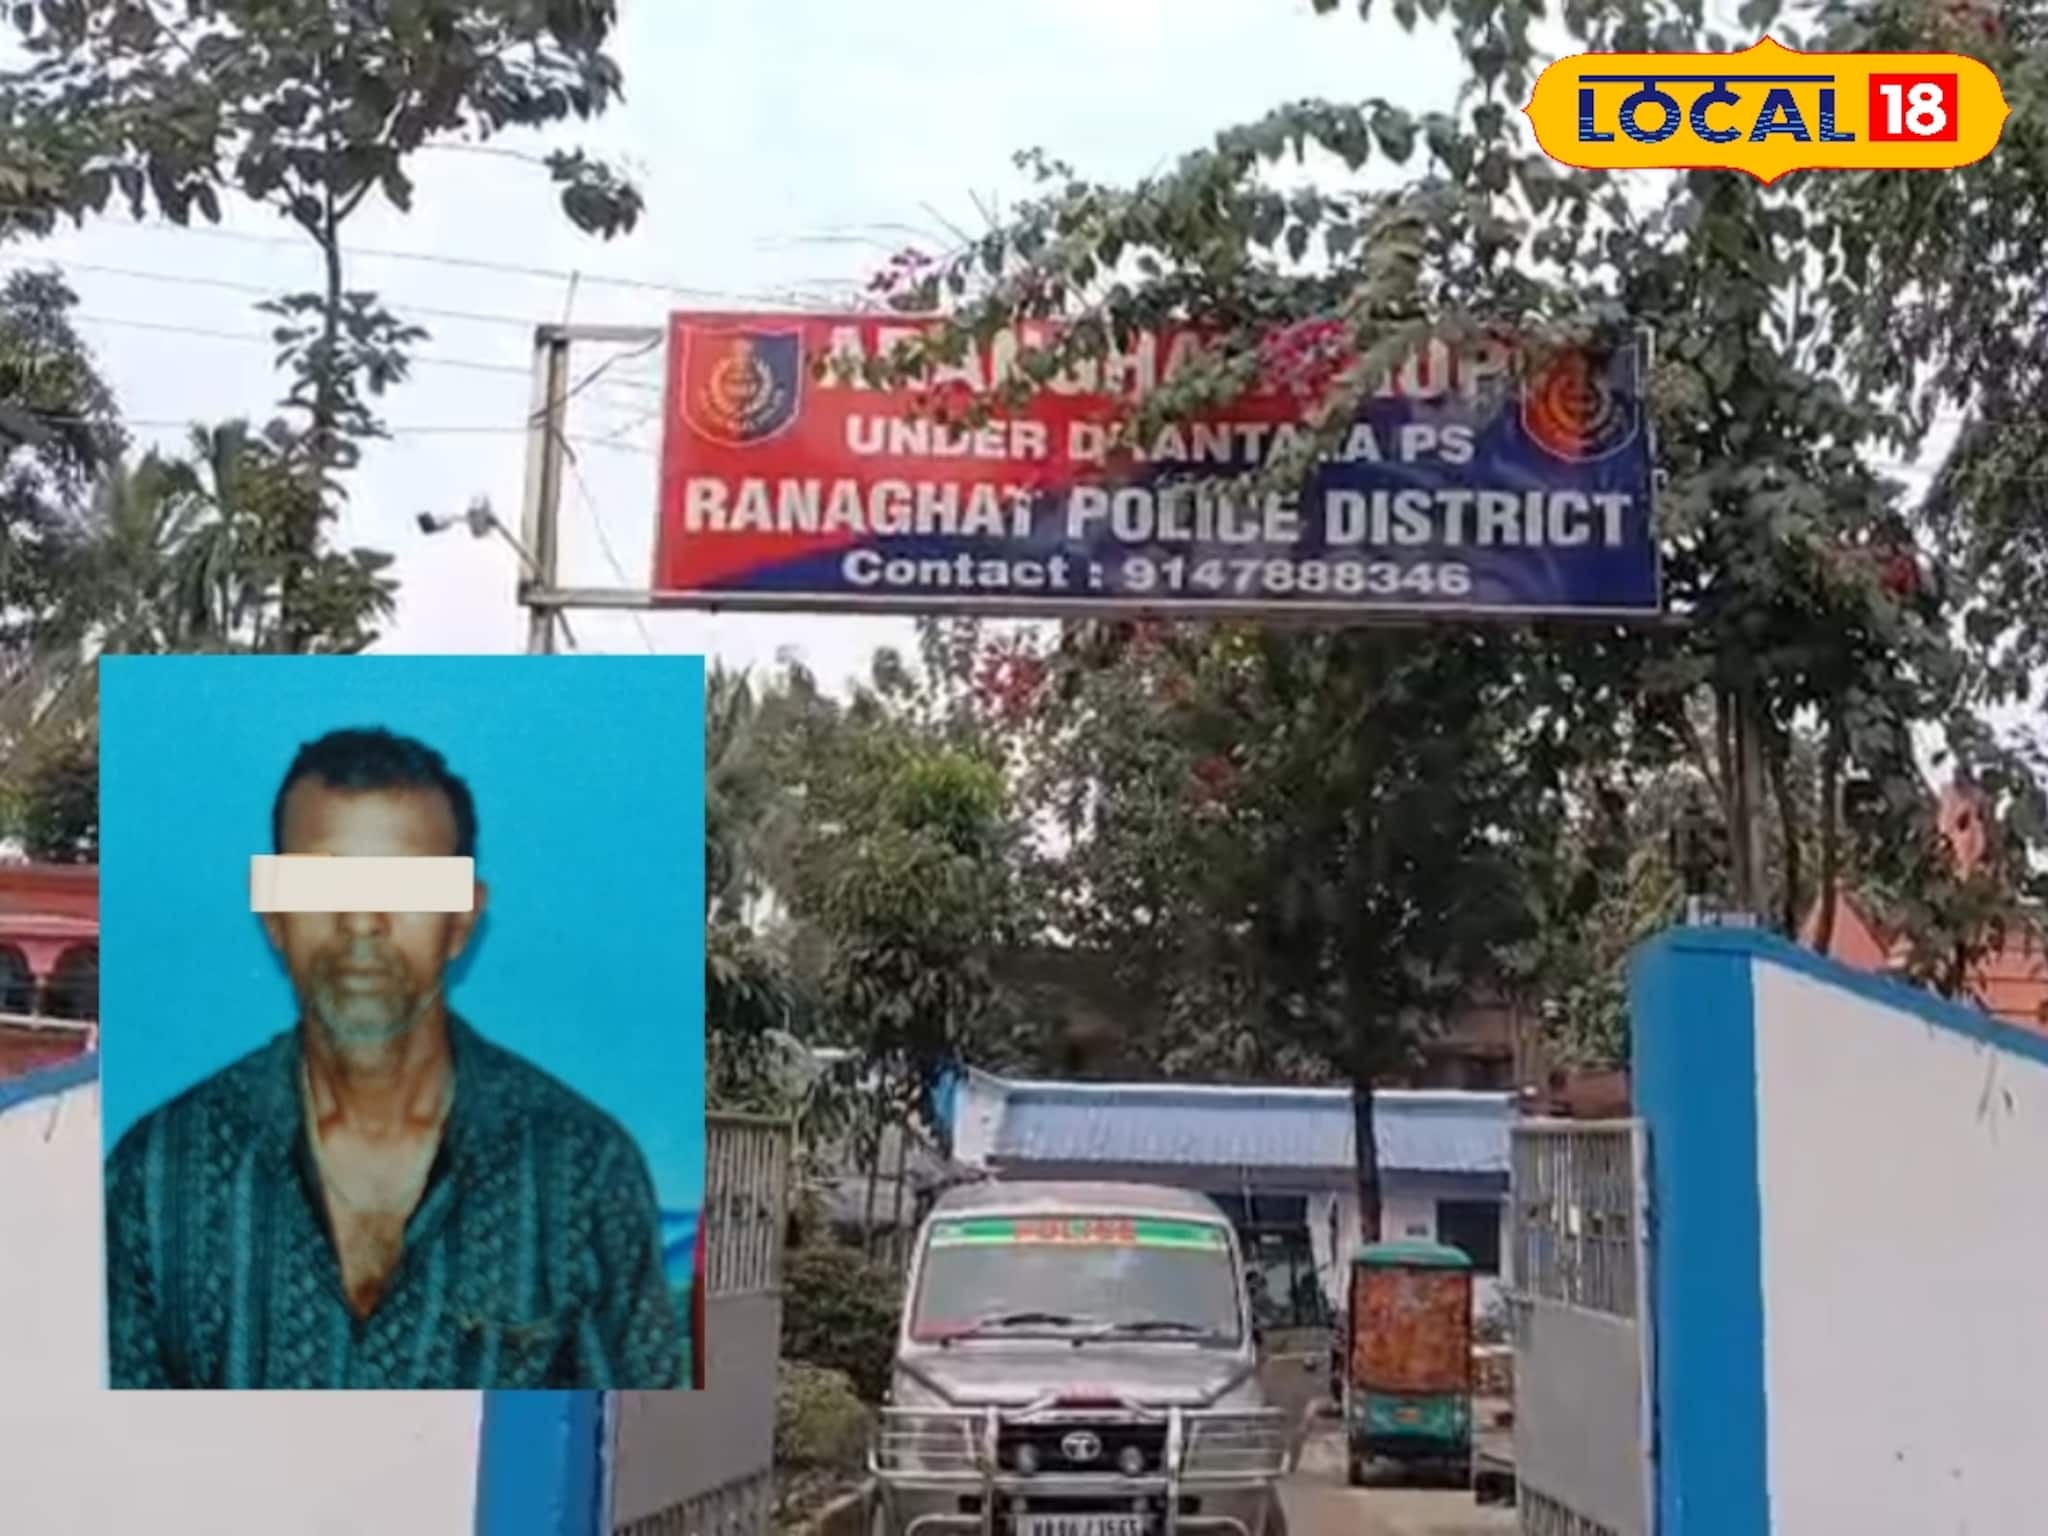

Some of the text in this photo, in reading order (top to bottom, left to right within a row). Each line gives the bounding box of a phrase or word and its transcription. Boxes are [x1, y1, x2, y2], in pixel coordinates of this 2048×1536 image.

[846, 415, 1475, 466] UNDER DANTAA PS
[684, 477, 1633, 547] RANAGHAT POLICE DISTRICT
[841, 548, 1070, 588] Contact
[1121, 555, 1472, 595] 9147888346
